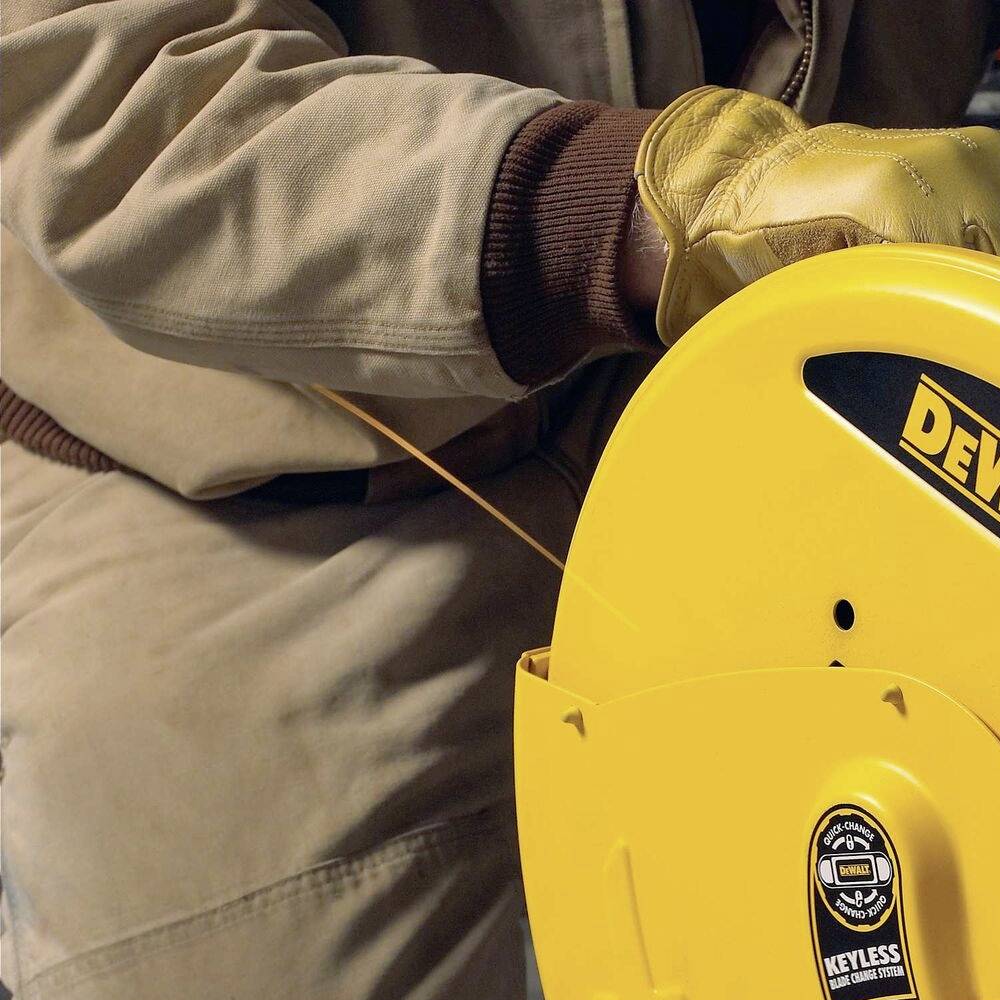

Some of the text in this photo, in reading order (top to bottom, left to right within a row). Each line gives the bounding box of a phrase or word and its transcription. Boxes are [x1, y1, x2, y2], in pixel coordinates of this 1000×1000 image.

[823, 821, 875, 846] QUICK-CHANGE
[836, 895, 887, 919] QUICK-CHANGE
[824, 943, 901, 977] KEYLESS
[829, 965, 905, 990] BLADE CHANGE SYSTEM
